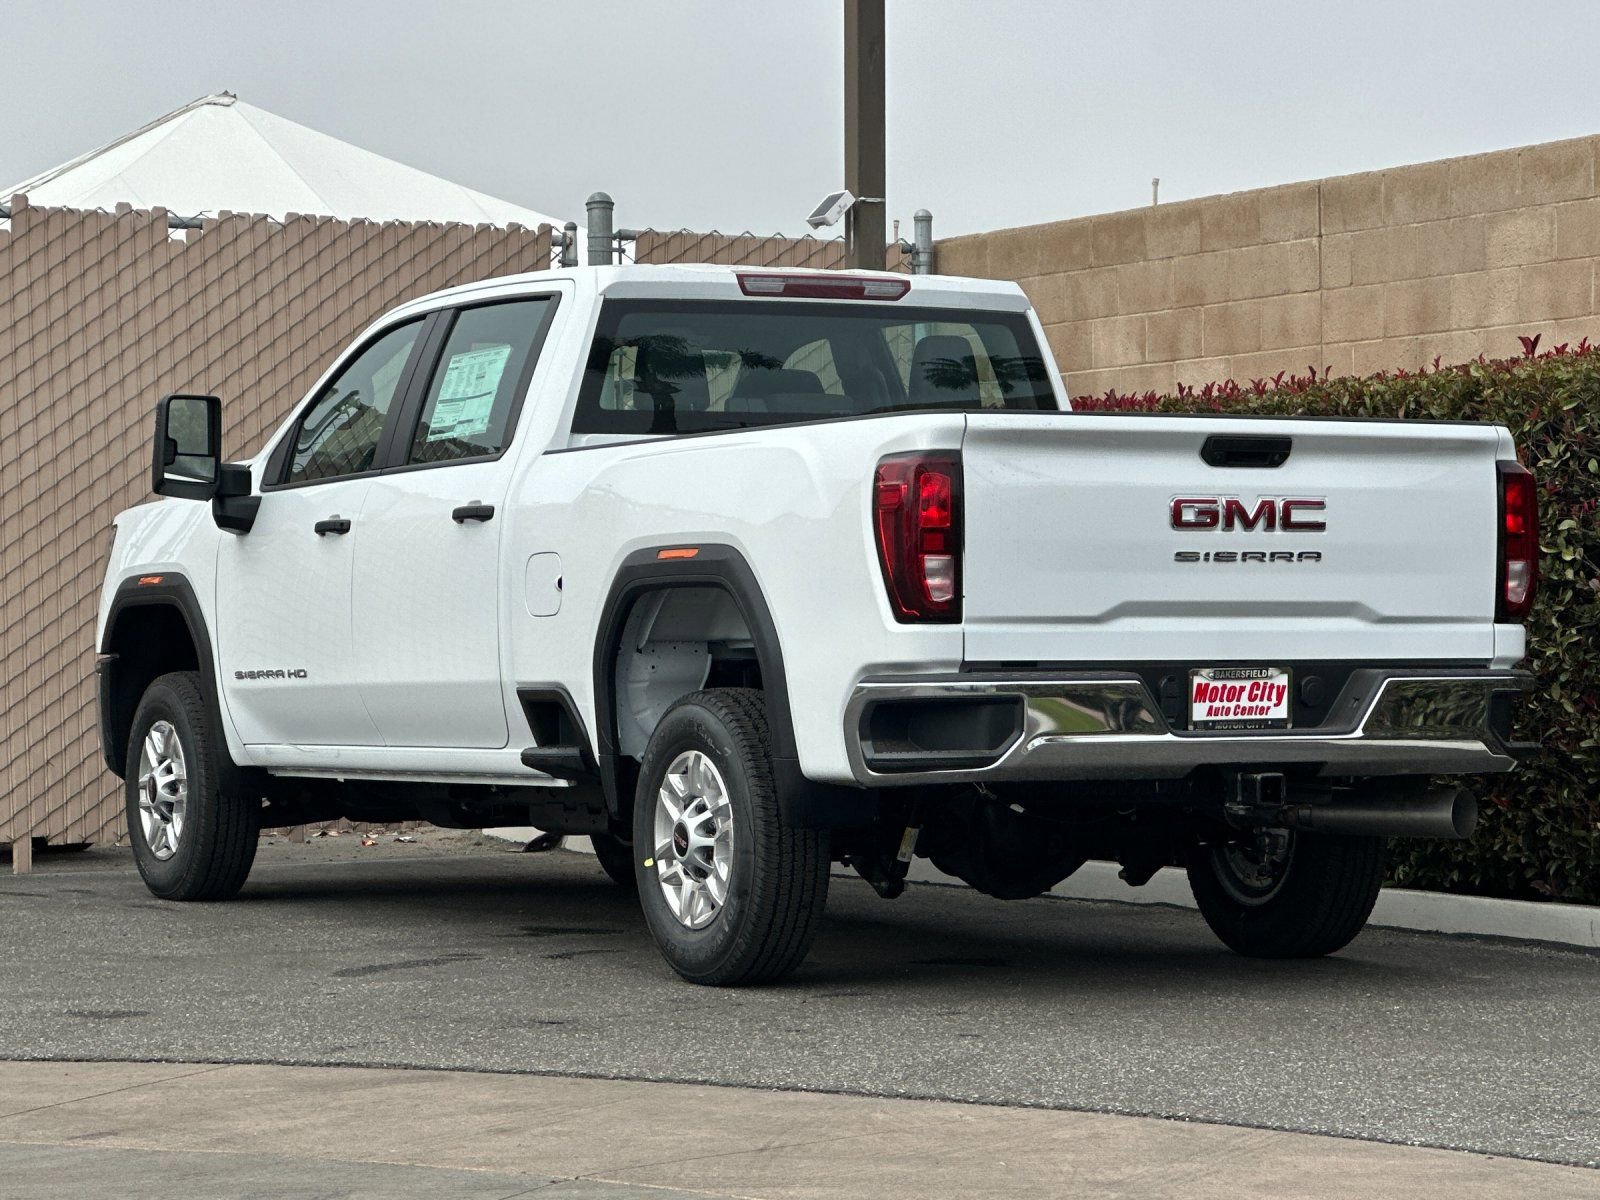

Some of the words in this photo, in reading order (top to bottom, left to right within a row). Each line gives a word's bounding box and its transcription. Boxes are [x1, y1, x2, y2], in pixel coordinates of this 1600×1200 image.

[1170, 494, 1327, 533] GMC
[1174, 551, 1322, 562] SIERRA
[234, 670, 285, 680] SIERRA
[287, 669, 307, 679] HD
[1215, 670, 1268, 679] BAKERSFIELD
[1193, 682, 1246, 703] Motor
[1247, 681, 1287, 707] City
[1206, 705, 1231, 717] Auto
[1233, 704, 1271, 716] Center
